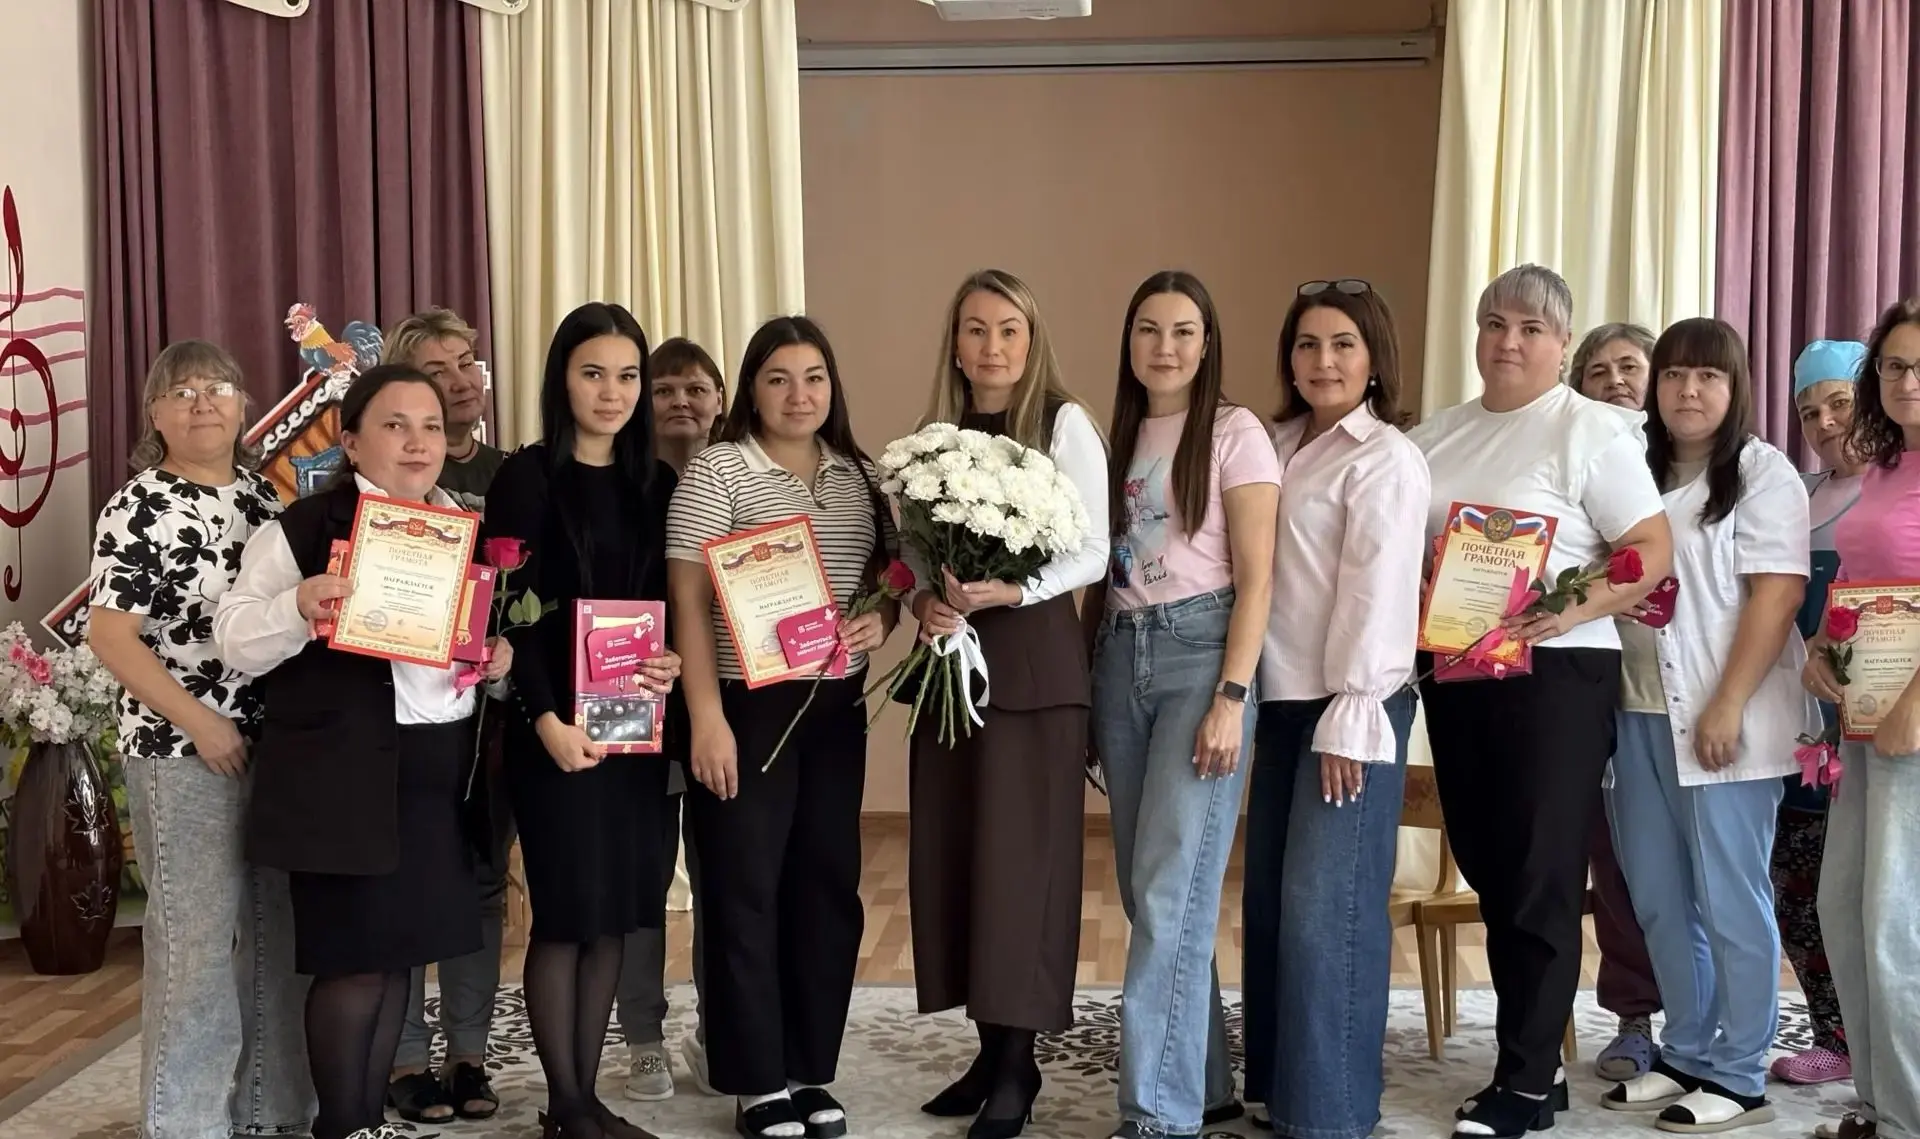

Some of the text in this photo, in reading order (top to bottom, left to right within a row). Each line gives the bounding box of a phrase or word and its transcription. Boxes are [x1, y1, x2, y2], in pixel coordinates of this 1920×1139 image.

[1464, 553, 1516, 568] ГРАМОТА
[384, 576, 433, 590] НАГРАЖДАЕТСЯ
[1144, 570, 1167, 586] Paris
